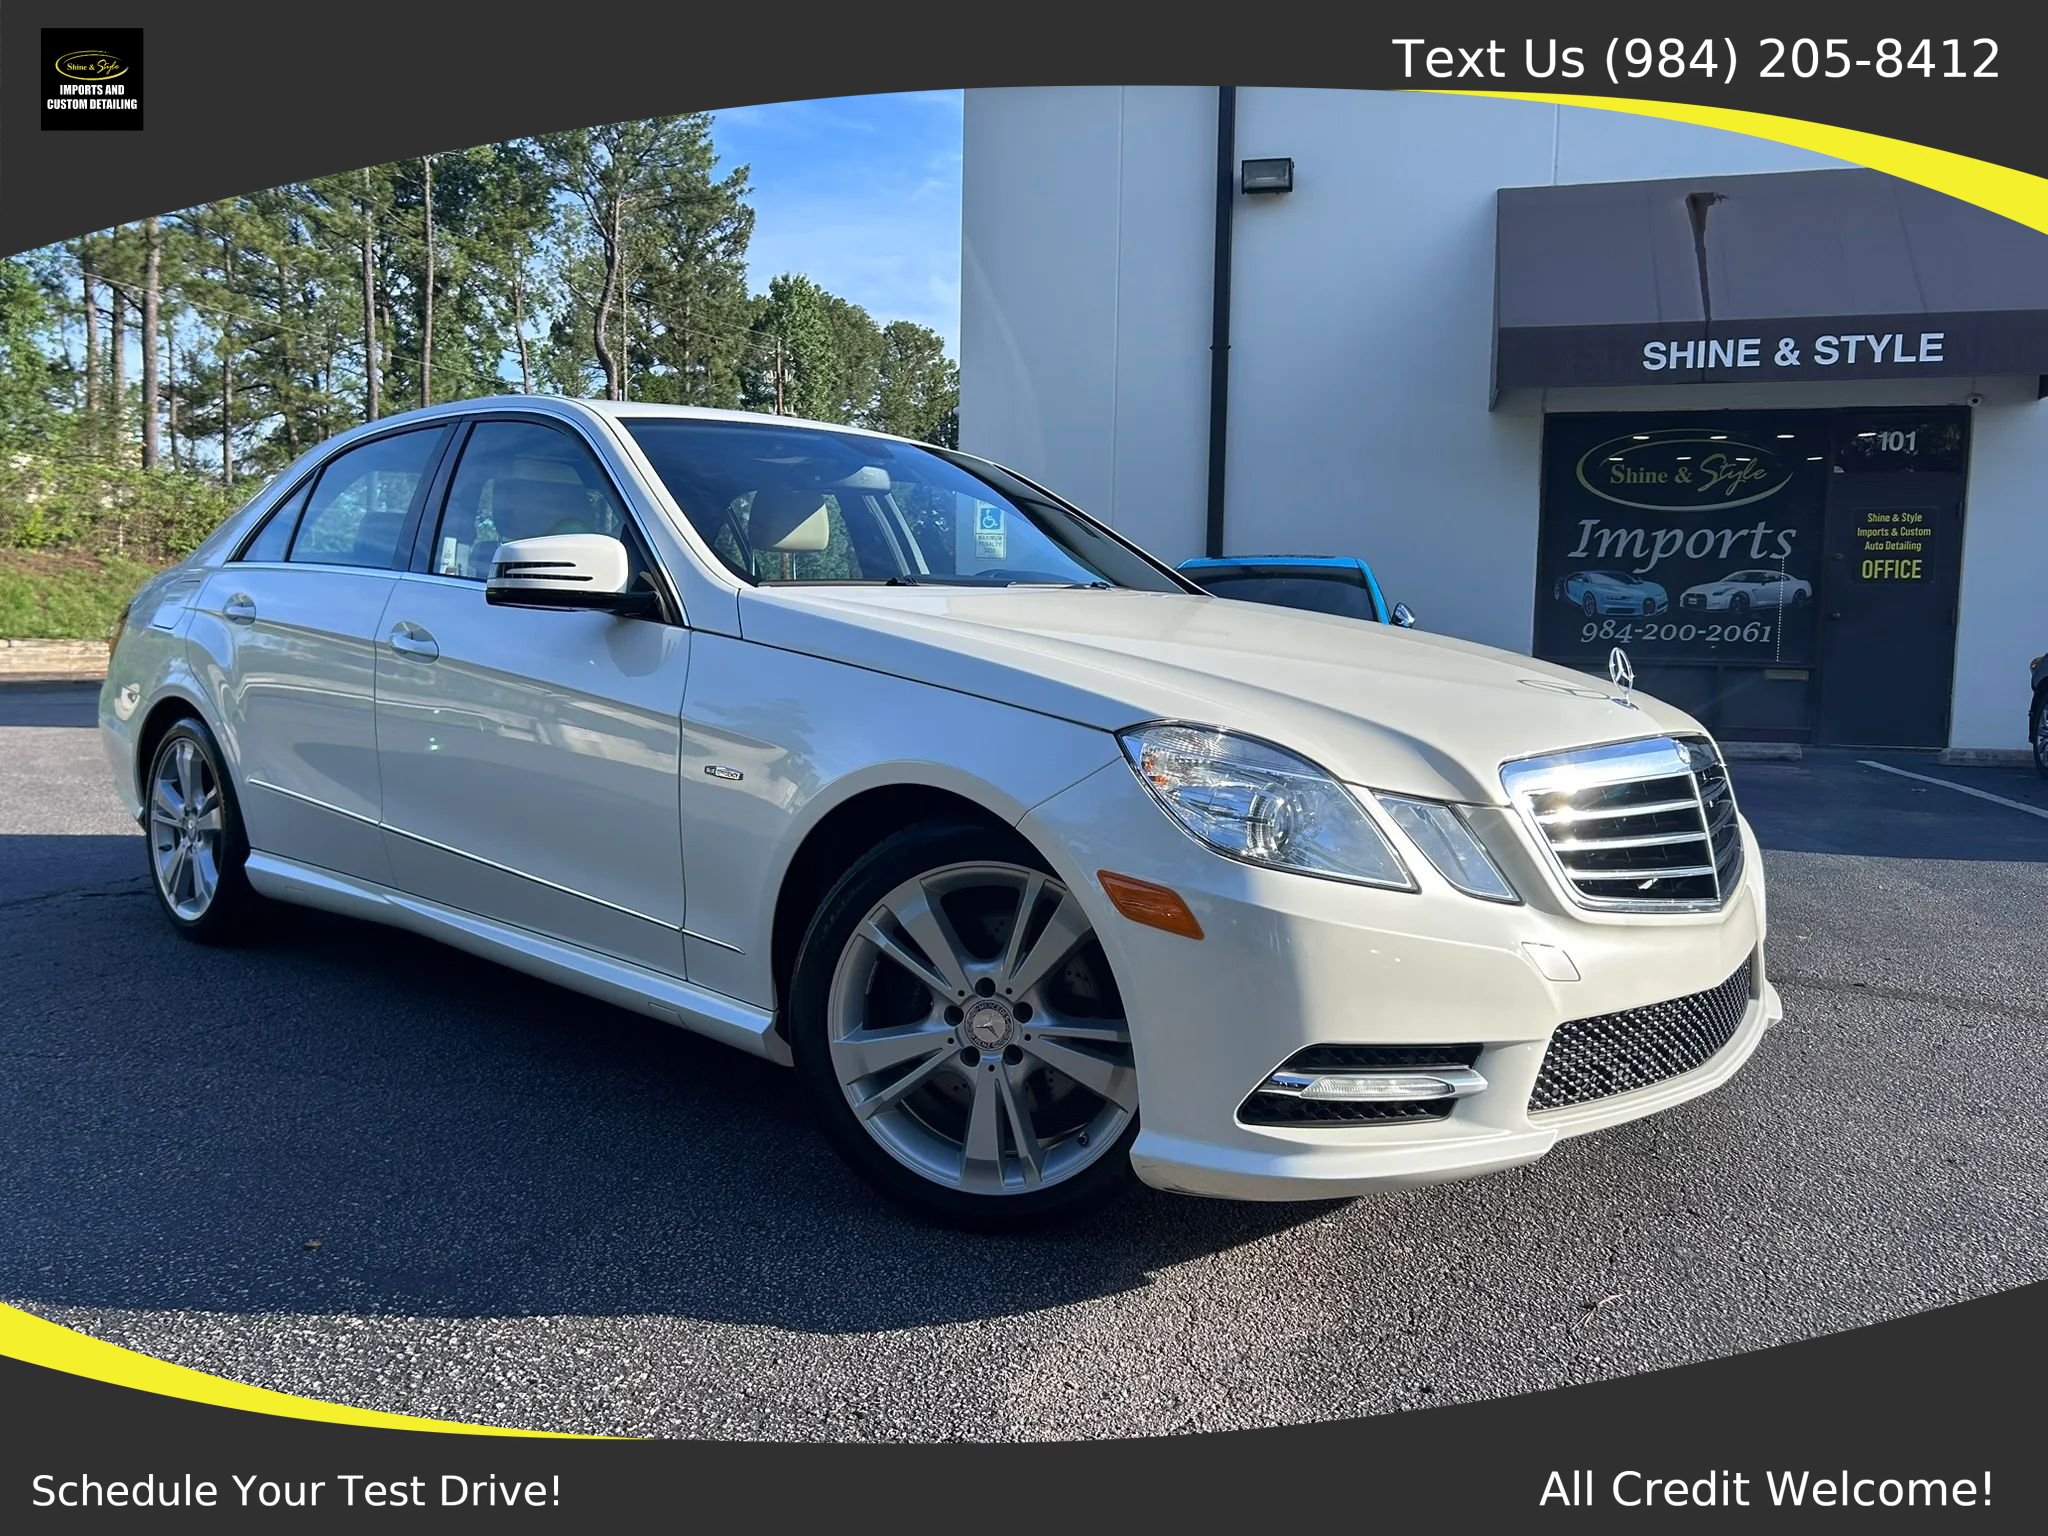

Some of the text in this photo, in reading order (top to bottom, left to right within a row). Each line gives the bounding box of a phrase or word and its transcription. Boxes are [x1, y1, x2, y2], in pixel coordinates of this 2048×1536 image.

[1642, 332, 1945, 371] SHINE & STYLE
[1878, 430, 1917, 452] 101
[1610, 453, 1768, 496] Shine & Style
[1867, 512, 1923, 524] Shine & Style
[1857, 526, 1931, 538] Imports & Custom
[1567, 519, 1797, 574] Imports
[1864, 540, 1922, 552] Auto Detailing
[1861, 559, 1923, 579] OFFICE
[1580, 619, 1771, 644] 984-200-2061
